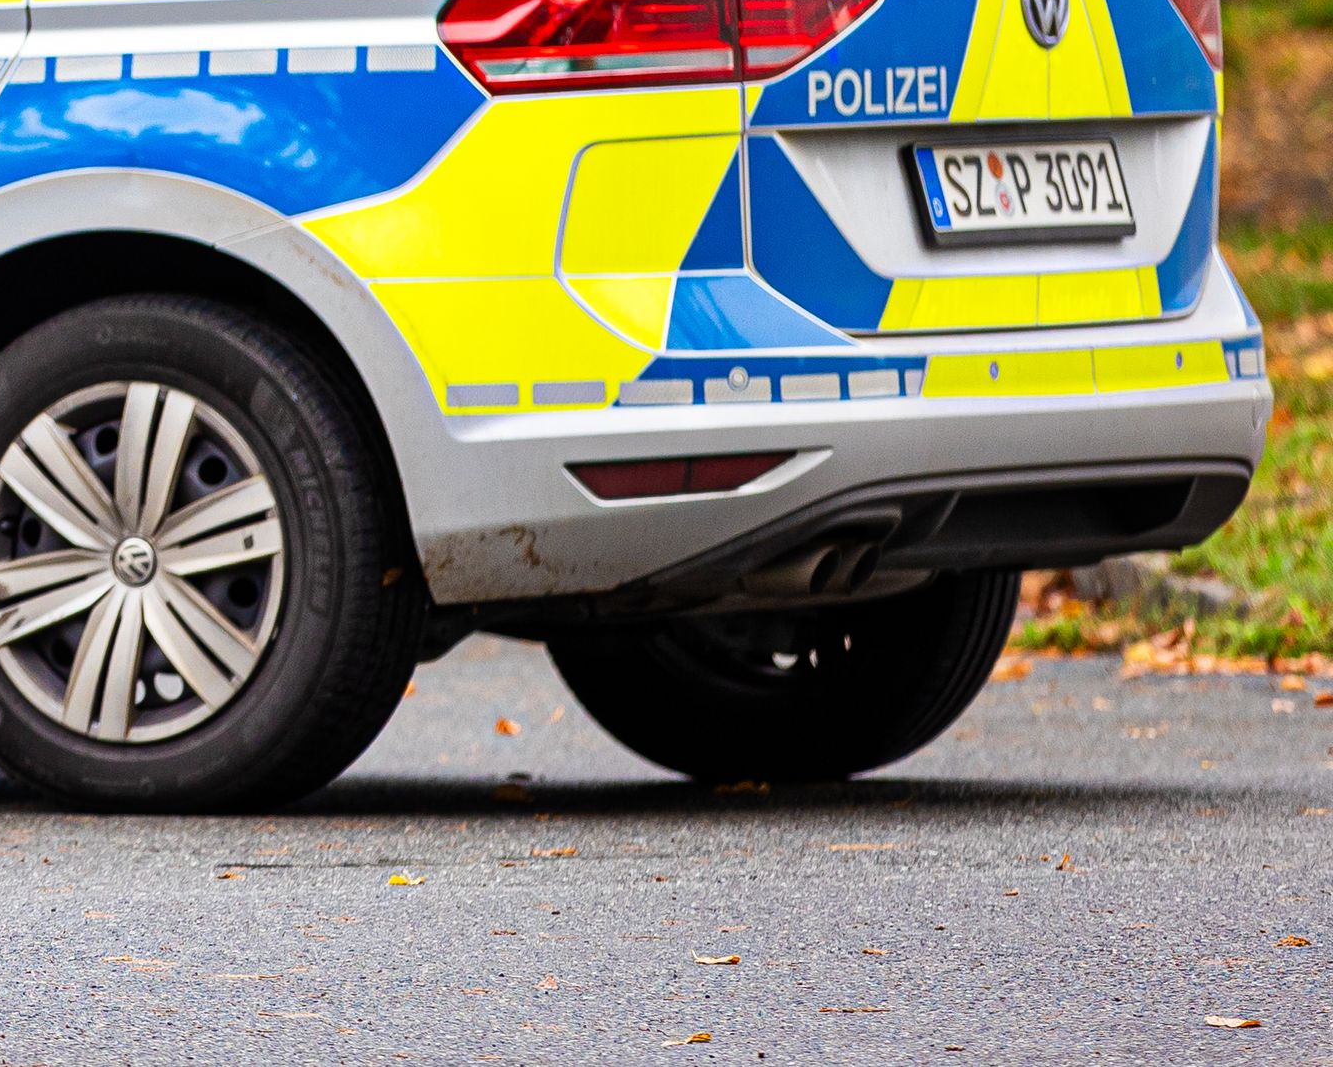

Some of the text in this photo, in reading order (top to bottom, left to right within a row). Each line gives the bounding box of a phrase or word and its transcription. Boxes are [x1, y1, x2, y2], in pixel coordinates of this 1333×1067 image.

[808, 65, 948, 117] POLIZEI
[943, 151, 1124, 217] SZ P 3091
